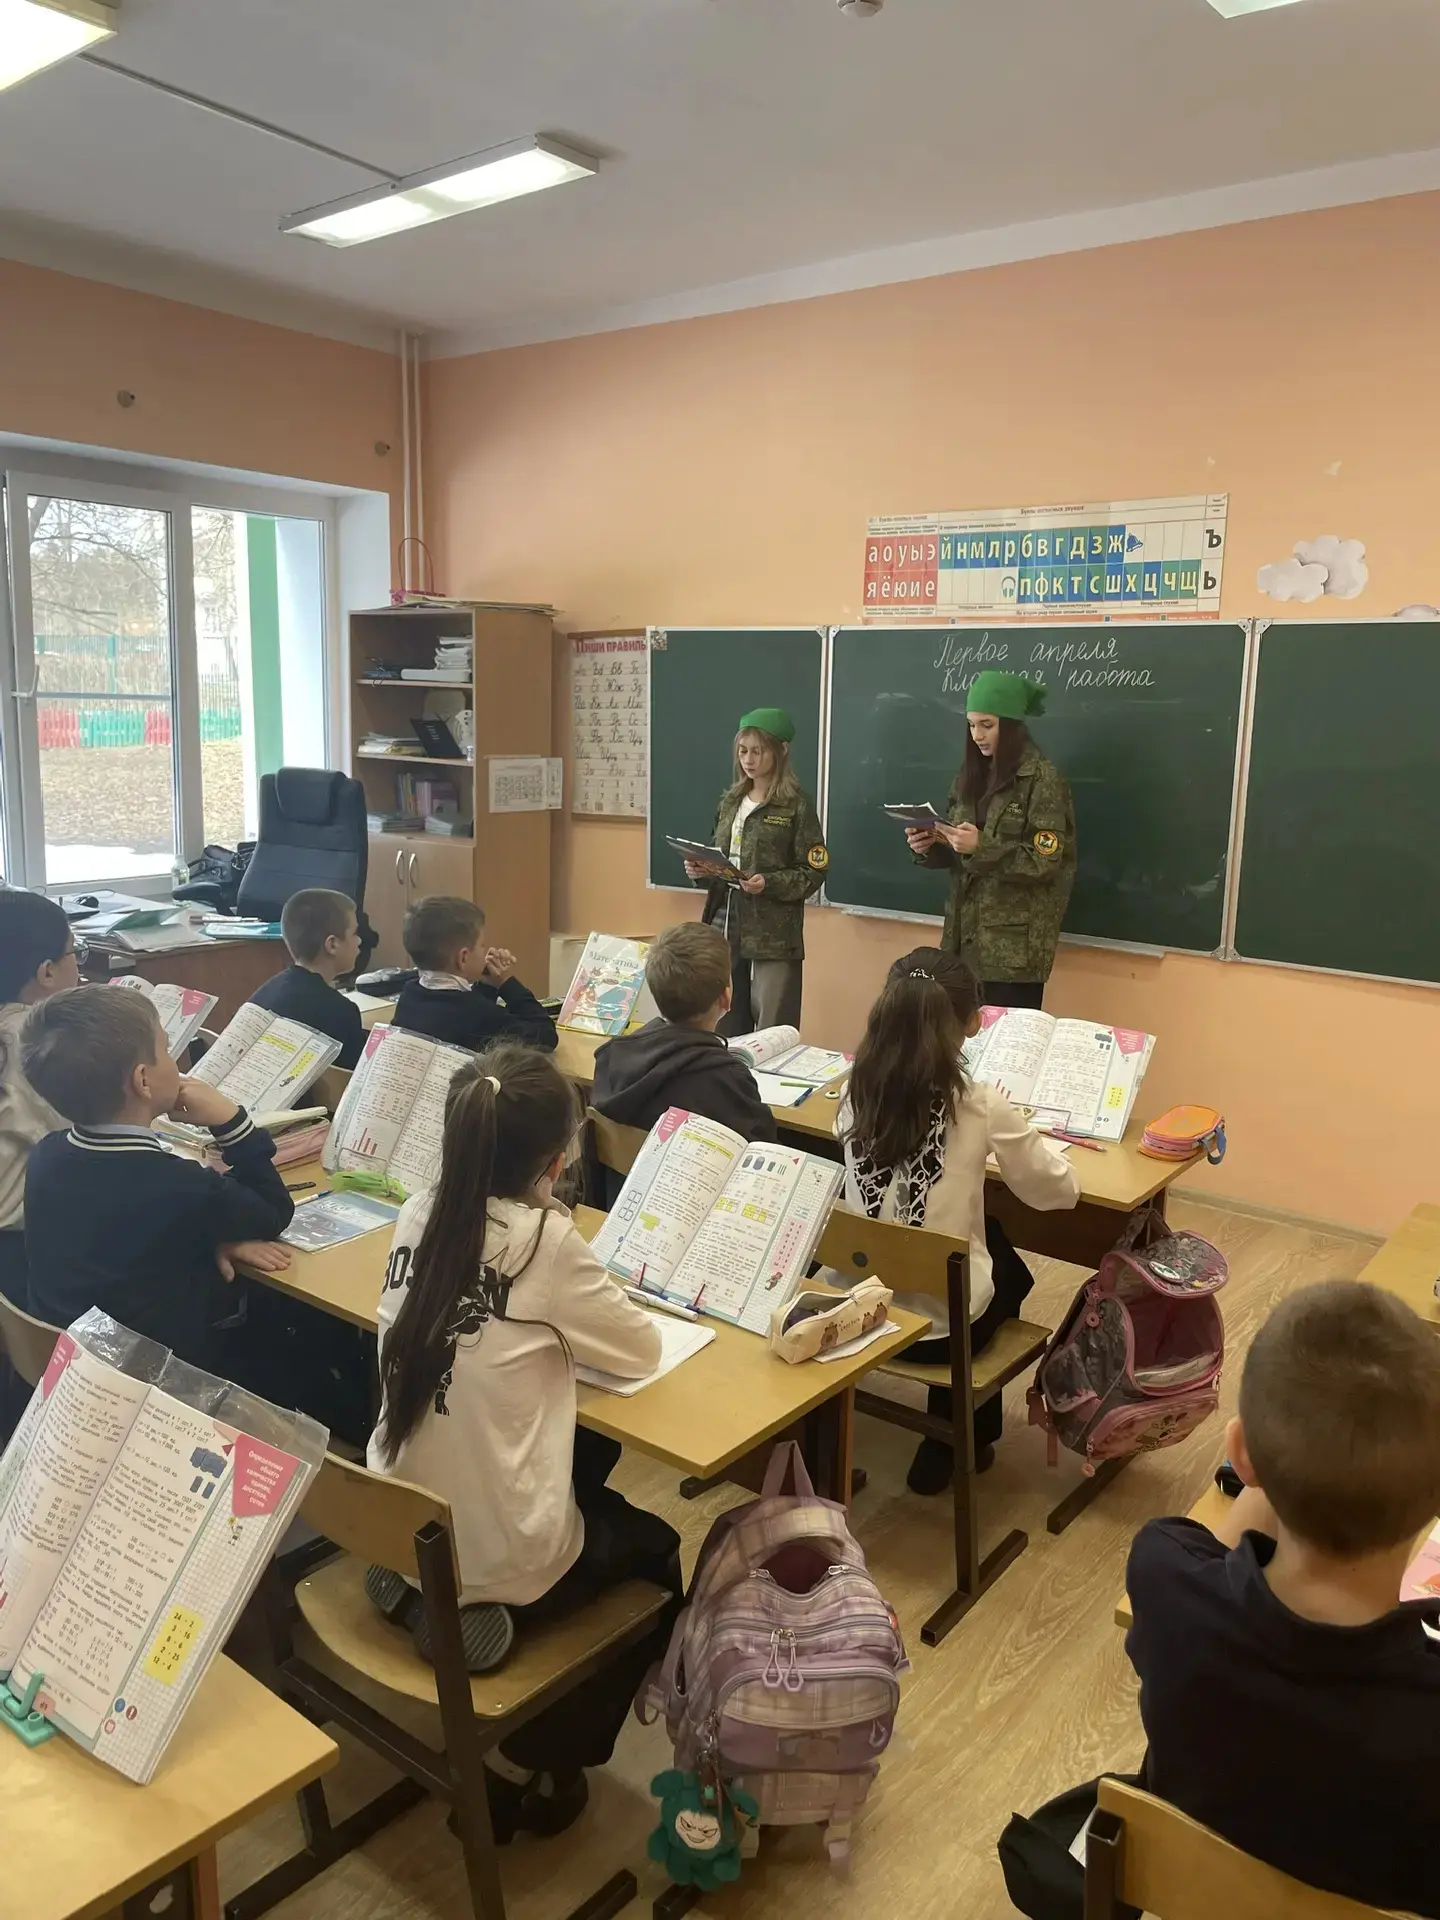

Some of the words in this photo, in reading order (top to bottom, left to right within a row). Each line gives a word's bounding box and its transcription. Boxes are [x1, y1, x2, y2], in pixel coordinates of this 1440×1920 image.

[933, 632, 1008, 677] Первое
[1030, 638, 1118, 676] апреля
[1066, 660, 1155, 692] работа
